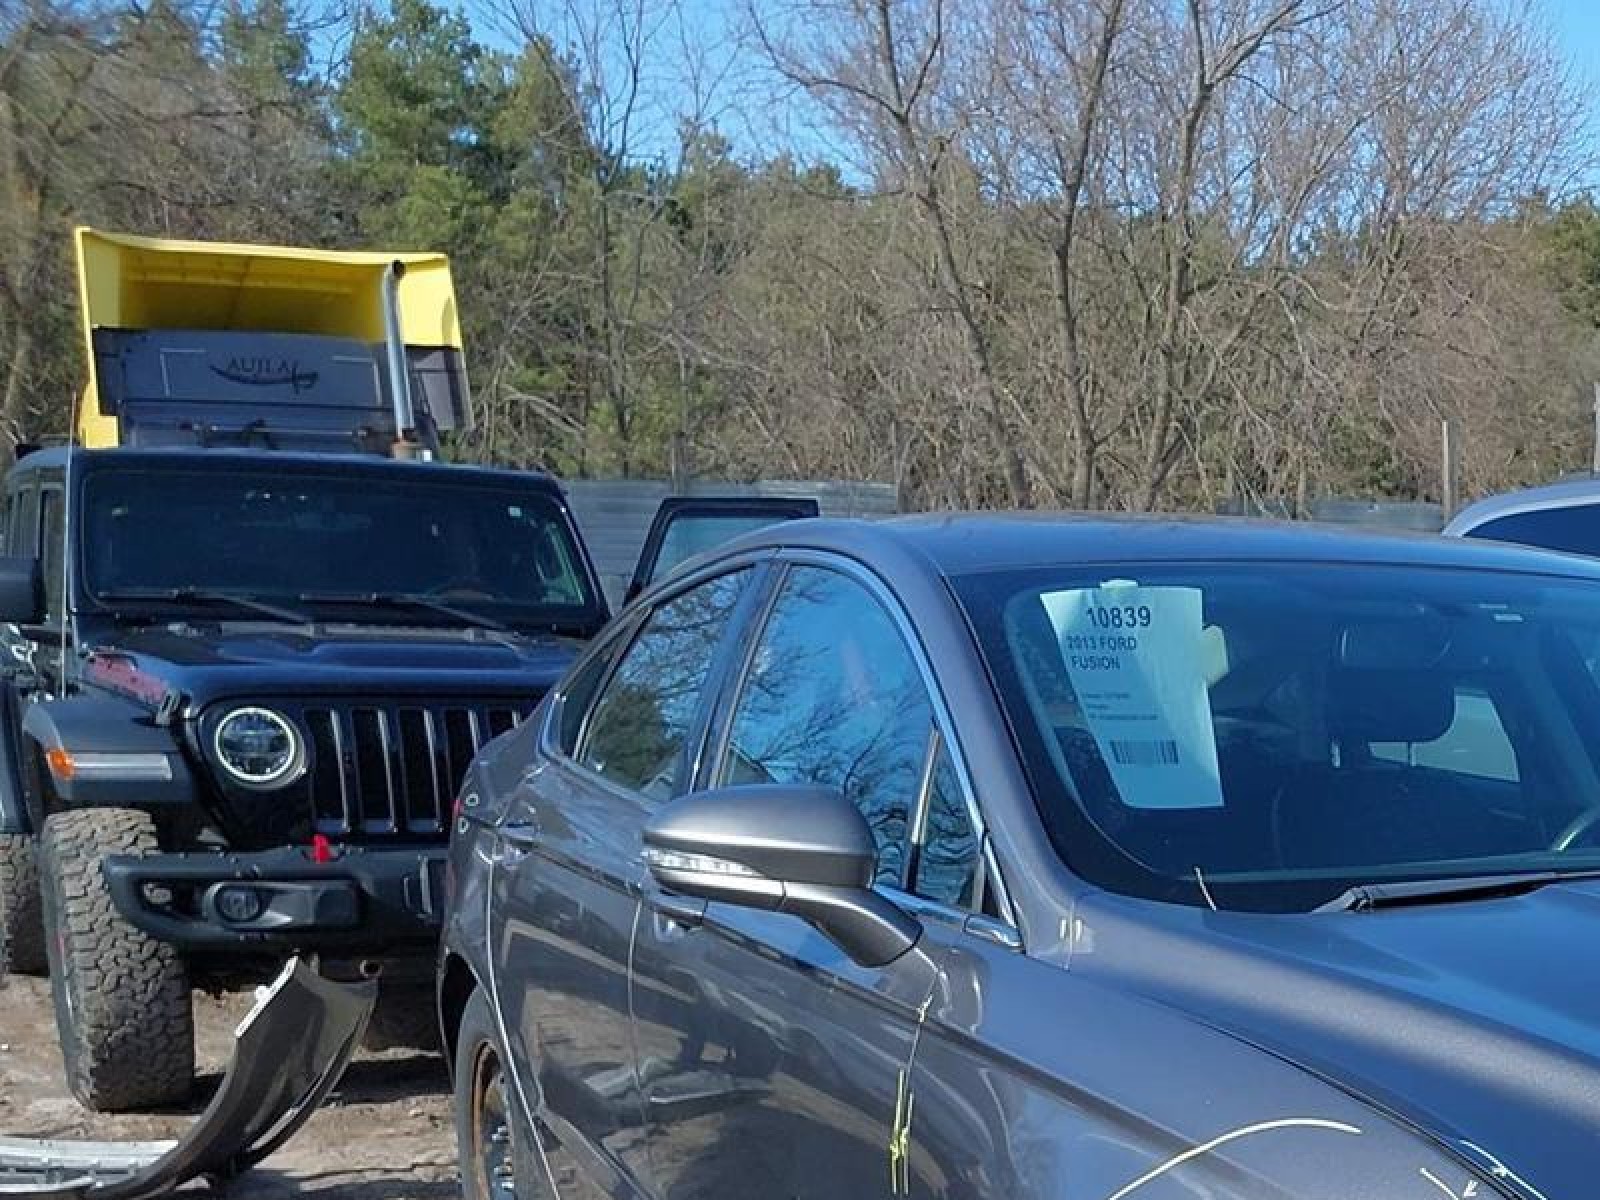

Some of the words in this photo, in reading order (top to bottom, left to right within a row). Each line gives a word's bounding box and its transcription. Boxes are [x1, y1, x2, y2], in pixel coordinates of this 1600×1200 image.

[1085, 605, 1152, 628] 10839
[1099, 634, 1138, 651] FORD
[1071, 655, 1121, 671] FUSION
